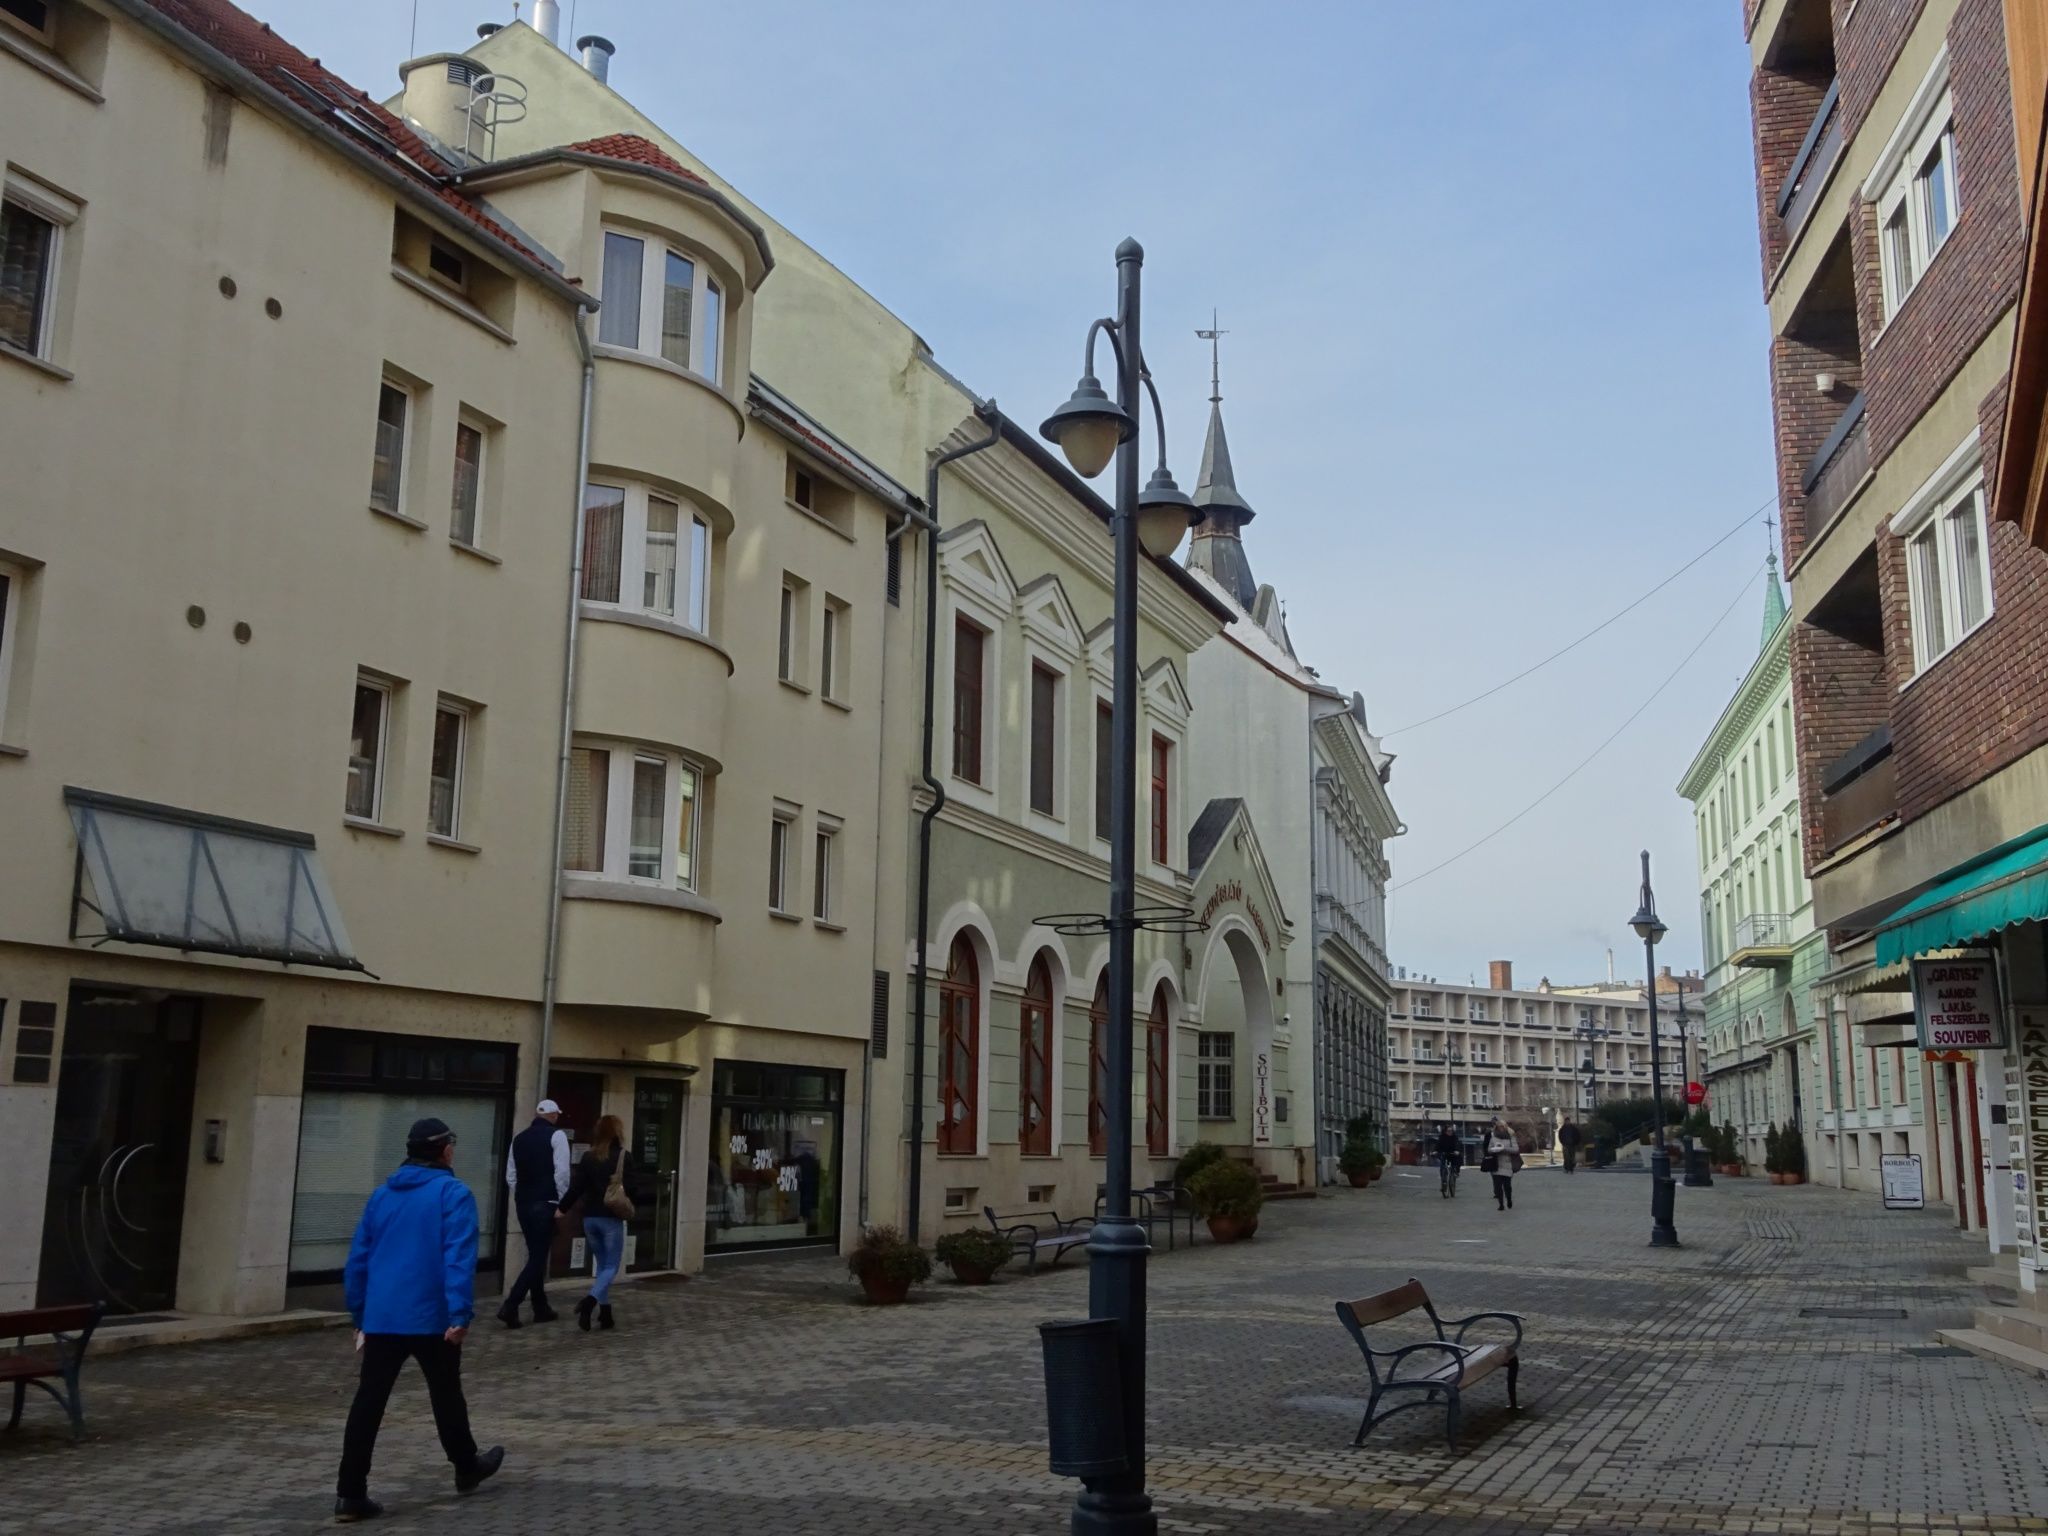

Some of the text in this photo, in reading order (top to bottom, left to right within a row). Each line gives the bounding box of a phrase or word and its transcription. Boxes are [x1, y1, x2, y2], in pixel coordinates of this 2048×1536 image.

[1938, 988, 1978, 999] AJÁNDÉK
[1941, 1001, 1976, 1013] LAKÁS-
[1930, 1012, 1990, 1025] FELSZERELÉS
[1934, 1030, 1991, 1044] SOUVENIR
[729, 1135, 748, 1154] -20%
[752, 1149, 773, 1170] -30%
[776, 1166, 798, 1192] -50%
